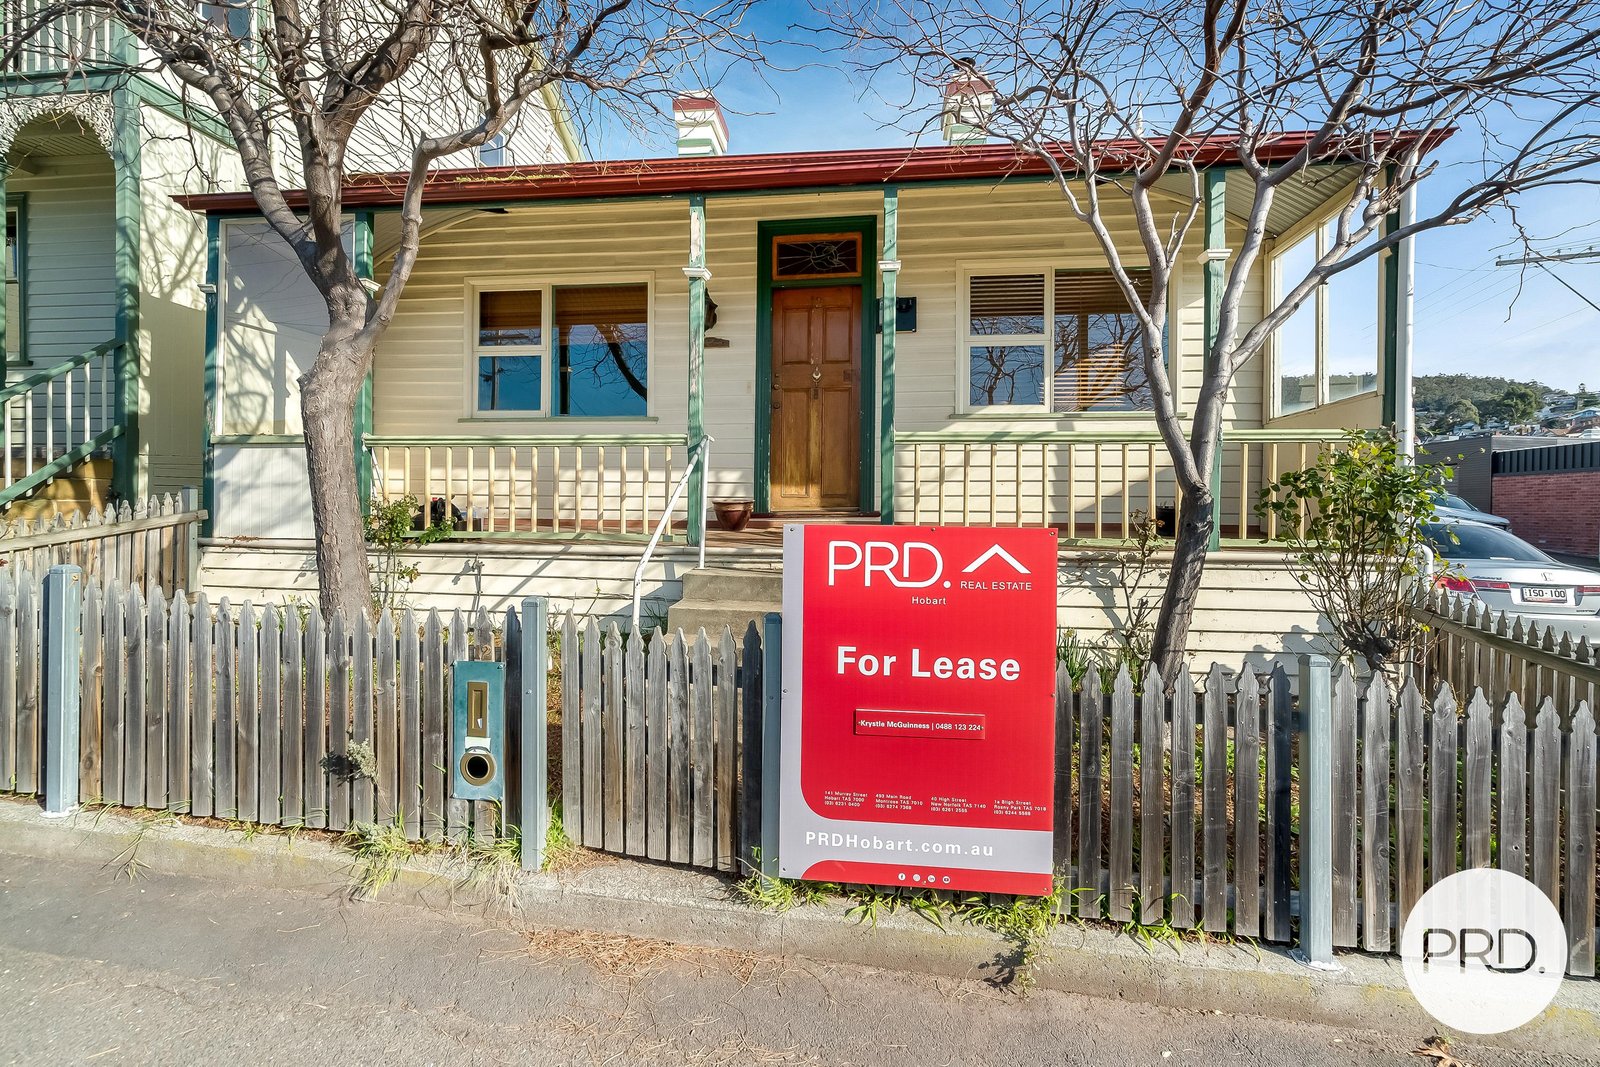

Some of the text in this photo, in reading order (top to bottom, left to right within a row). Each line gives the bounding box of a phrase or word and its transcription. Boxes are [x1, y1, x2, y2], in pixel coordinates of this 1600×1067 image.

[960, 580, 1032, 591] REAL ESTATE
[912, 596, 946, 605] Hobart
[837, 646, 1021, 681] For Lease
[886, 720, 930, 729] McGuinness
[805, 831, 994, 856] PRDHobart.com.au
